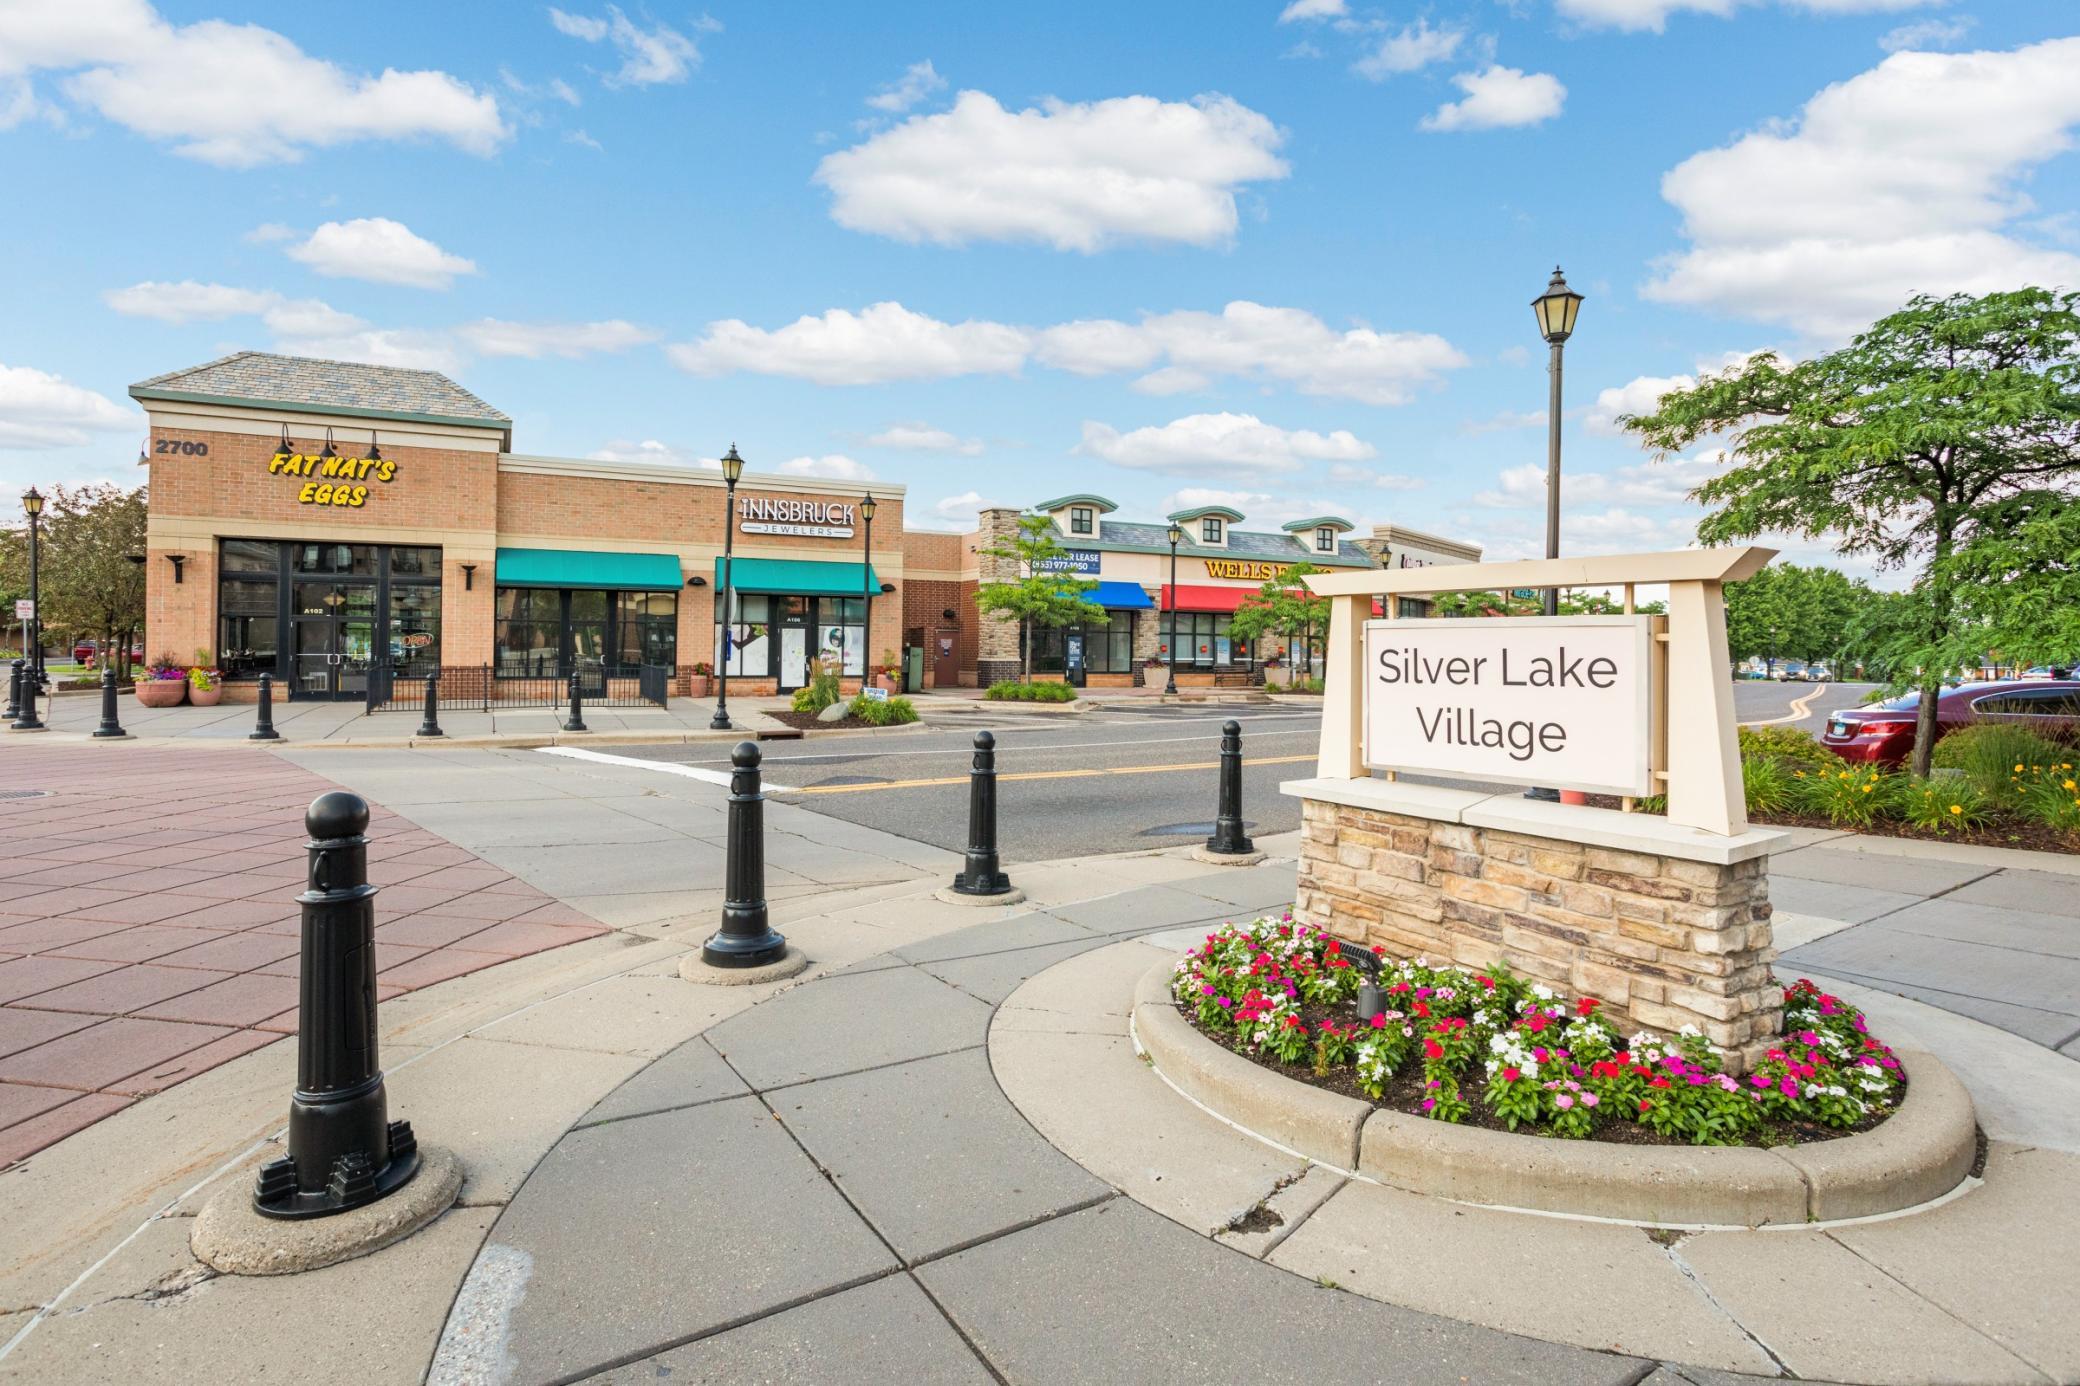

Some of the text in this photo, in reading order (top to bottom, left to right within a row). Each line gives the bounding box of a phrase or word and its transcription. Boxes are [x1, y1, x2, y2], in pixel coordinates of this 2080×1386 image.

[155, 439, 208, 457] 2700
[269, 453, 397, 481] FAT NAT'S
[298, 482, 369, 507] EGGS
[741, 497, 855, 526] INNSBRUCK
[763, 524, 833, 536] JEWELERS
[1076, 553, 1099, 562] LEASE
[1206, 560, 1273, 581] WELLS
[1379, 646, 1618, 689] Silver Lake
[1416, 706, 1567, 761] Village
